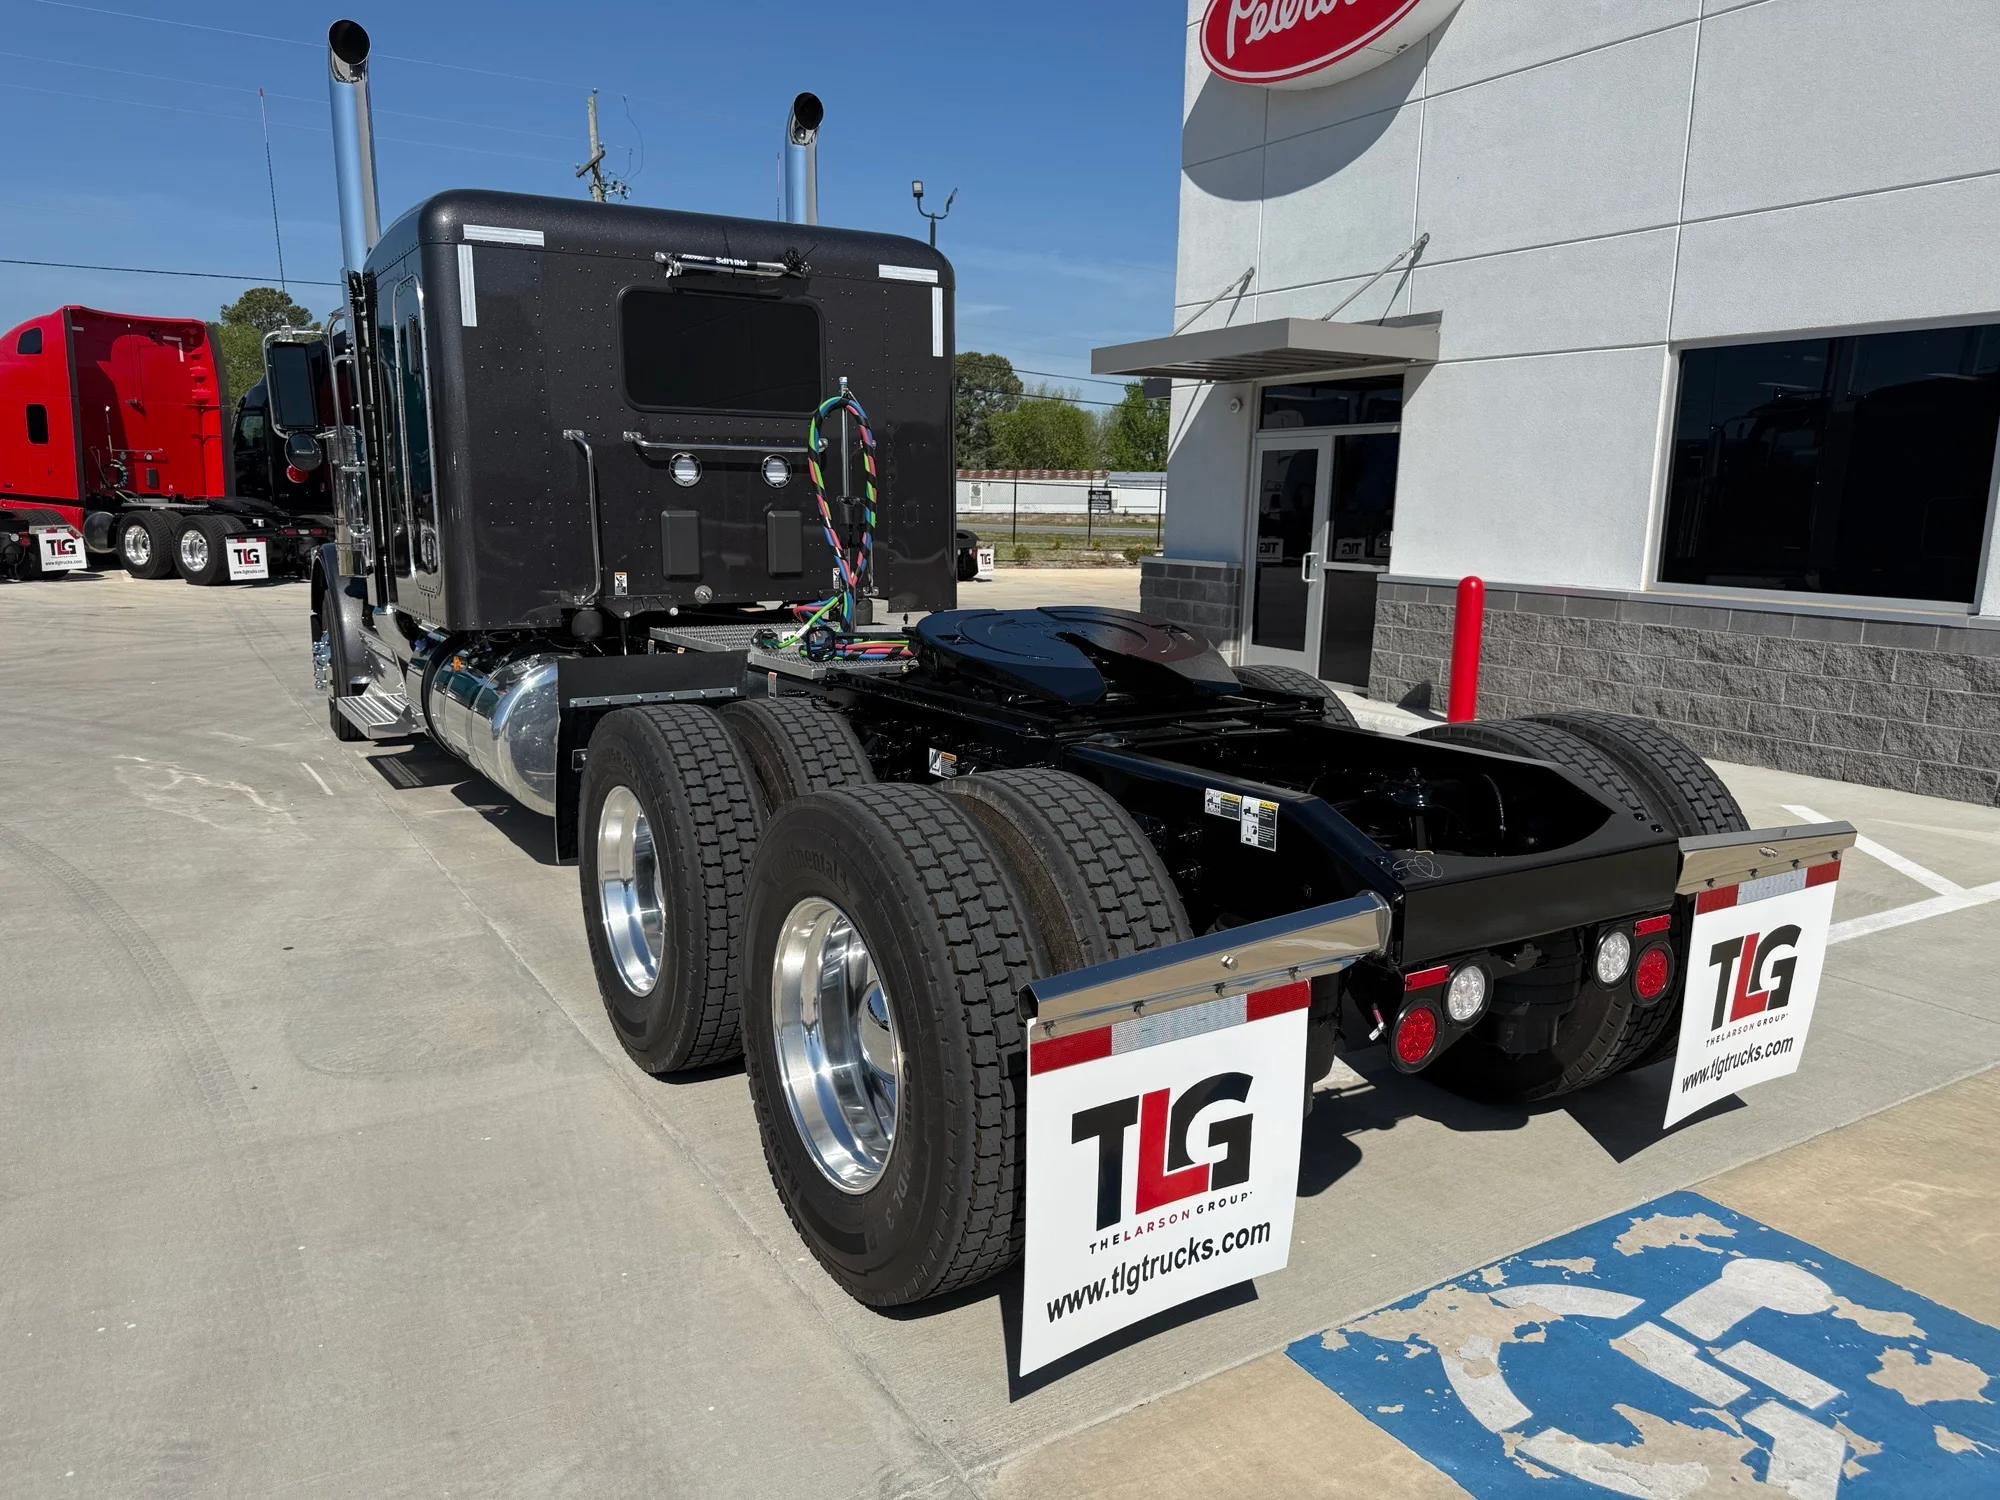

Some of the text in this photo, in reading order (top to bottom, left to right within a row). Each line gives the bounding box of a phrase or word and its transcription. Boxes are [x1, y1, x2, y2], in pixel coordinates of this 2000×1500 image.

[46, 539, 77, 556] TLG
[233, 548, 261, 565] TLG
[980, 553, 991, 565] TLG
[1709, 924, 1802, 1031] TLG
[1681, 1036, 1794, 1094] www.tlgtrucks.com
[1071, 1071, 1254, 1232] TLG
[1196, 1192, 1248, 1215] GROUP
[1046, 1221, 1271, 1323] www.tlgtrucks.com
